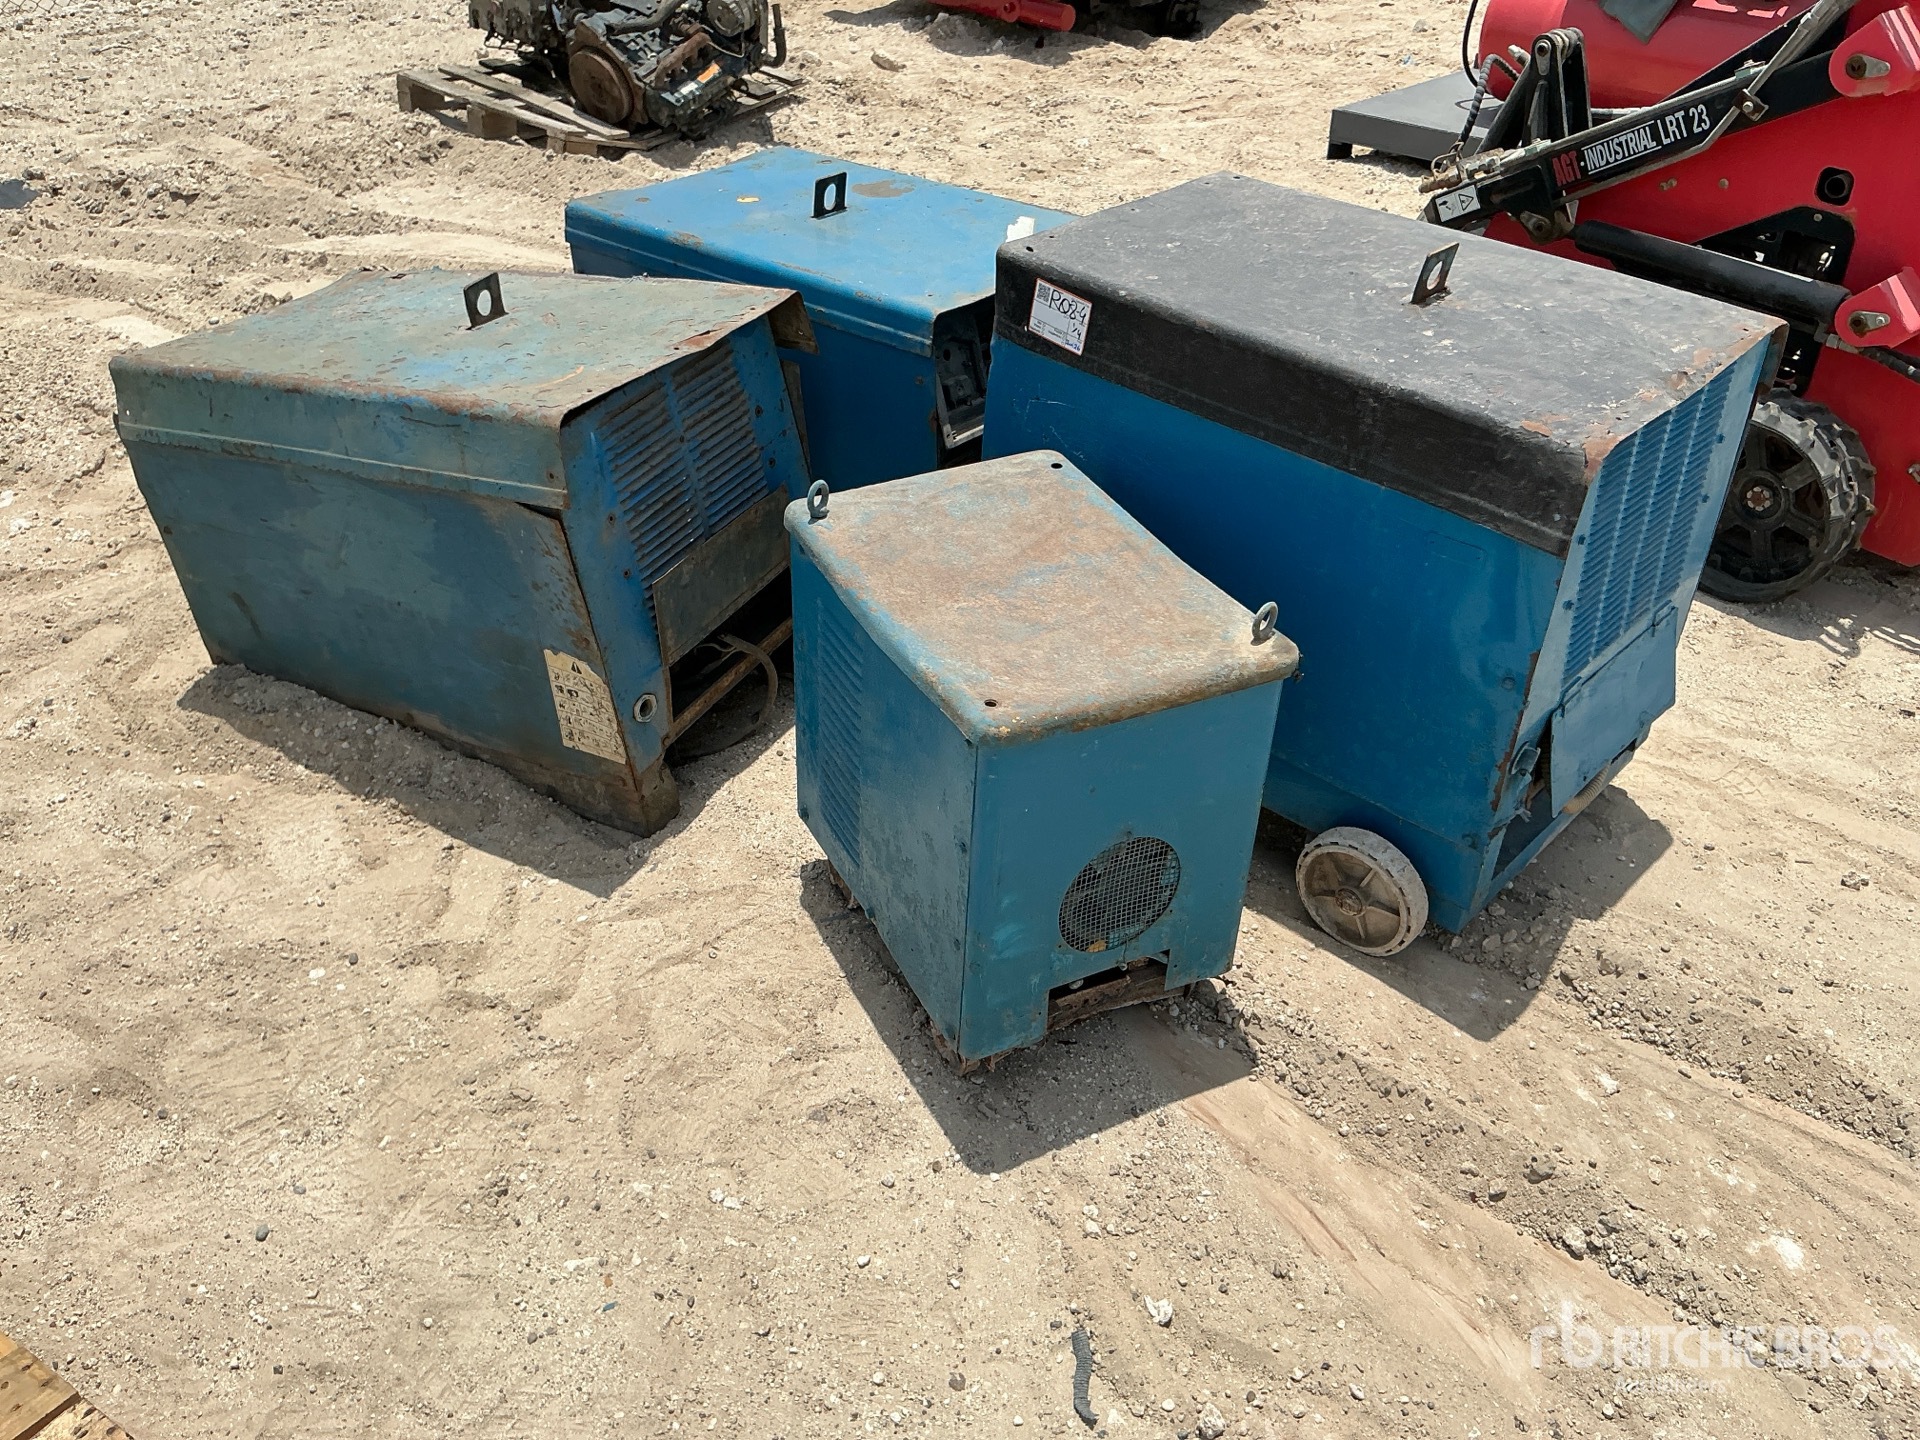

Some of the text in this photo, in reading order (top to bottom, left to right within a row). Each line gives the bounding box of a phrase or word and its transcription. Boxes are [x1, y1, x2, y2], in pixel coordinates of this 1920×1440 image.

[1552, 104, 1711, 186] AGT INDUSTRIAL LRT 23
